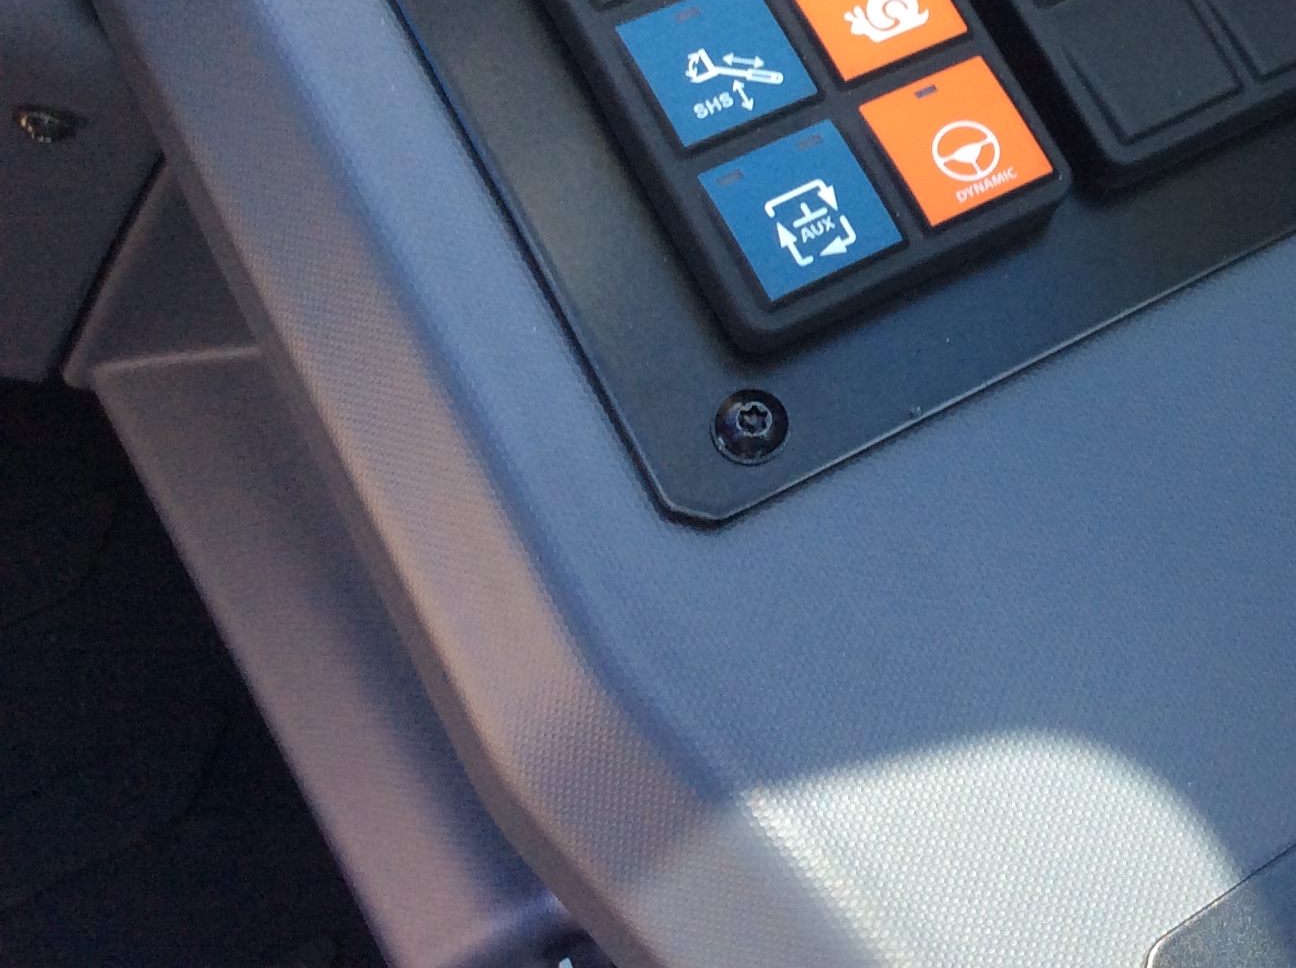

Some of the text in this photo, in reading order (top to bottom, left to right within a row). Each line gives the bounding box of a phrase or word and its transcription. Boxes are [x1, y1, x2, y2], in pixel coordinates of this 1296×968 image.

[693, 90, 734, 120] SHS
[955, 165, 1019, 204] DYNAMIC
[799, 215, 837, 244] AUX
